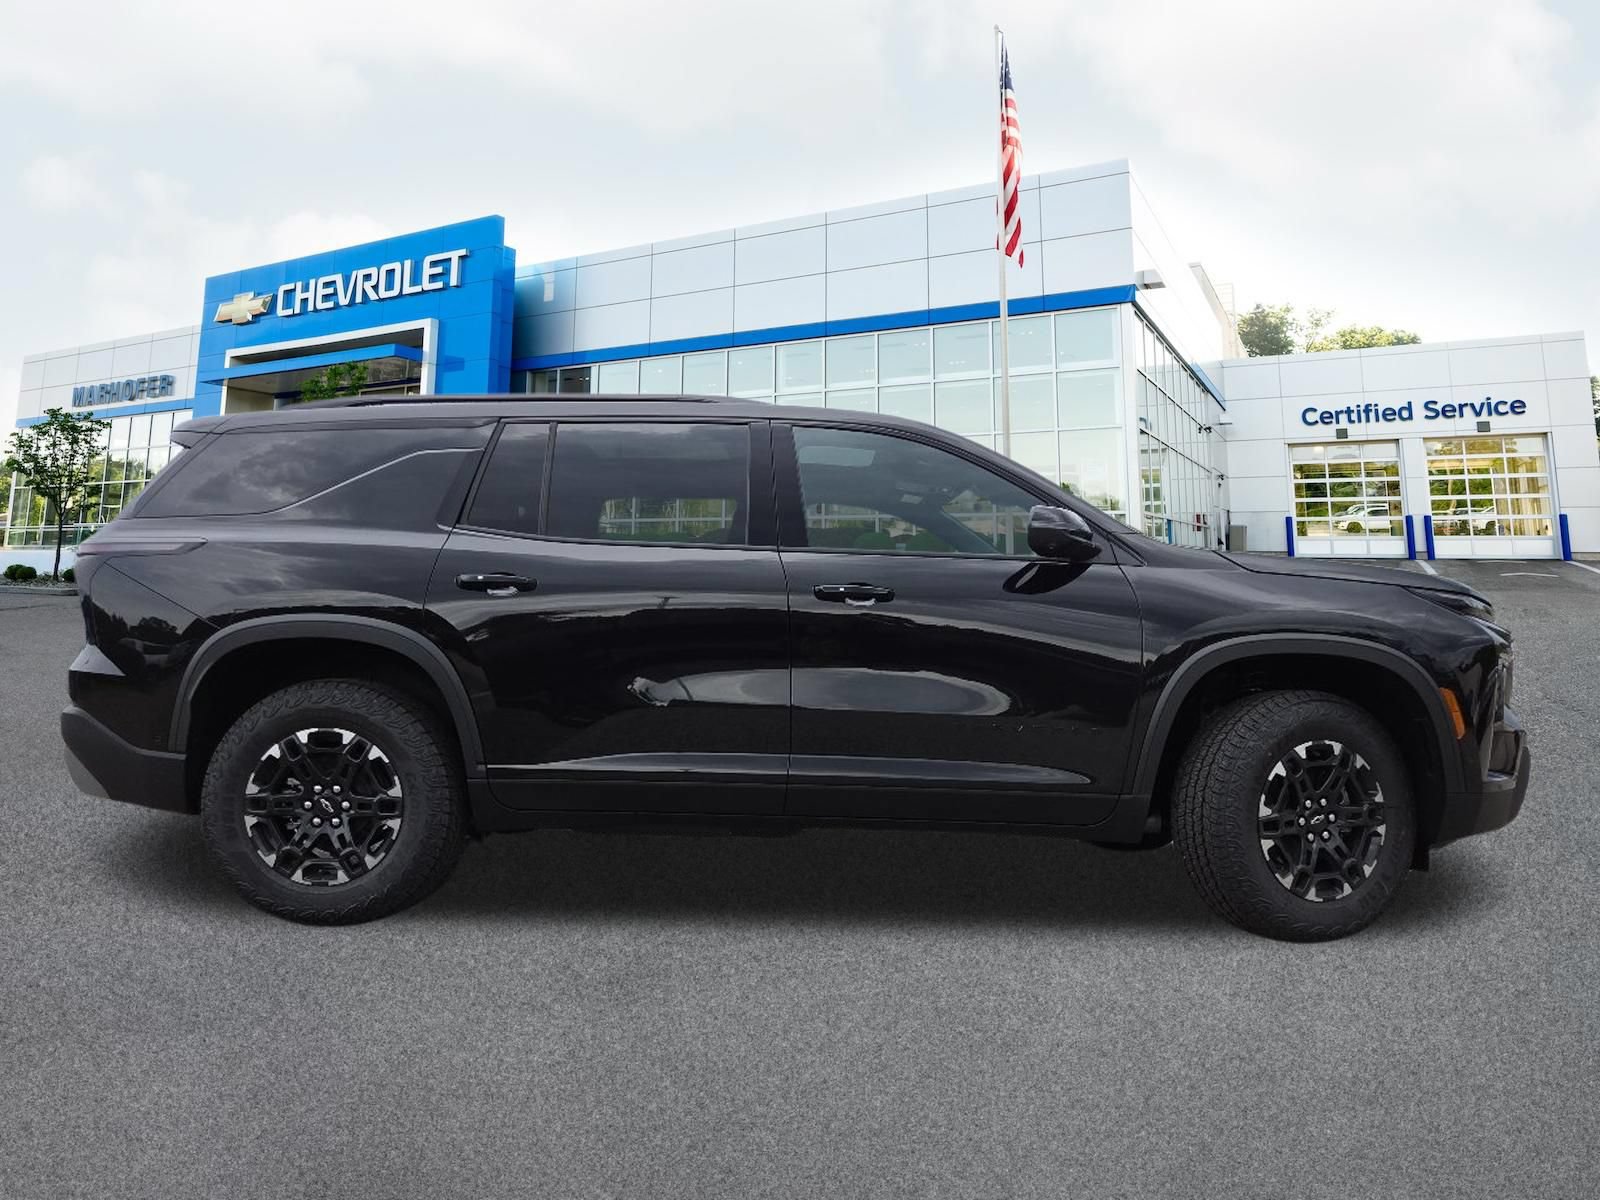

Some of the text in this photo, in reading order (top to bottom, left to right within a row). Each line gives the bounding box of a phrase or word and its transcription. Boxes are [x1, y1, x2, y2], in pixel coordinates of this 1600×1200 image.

[276, 248, 469, 317] CHEVROLET
[72, 375, 176, 407] MARHOFER
[1301, 396, 1527, 426] Certified Service
